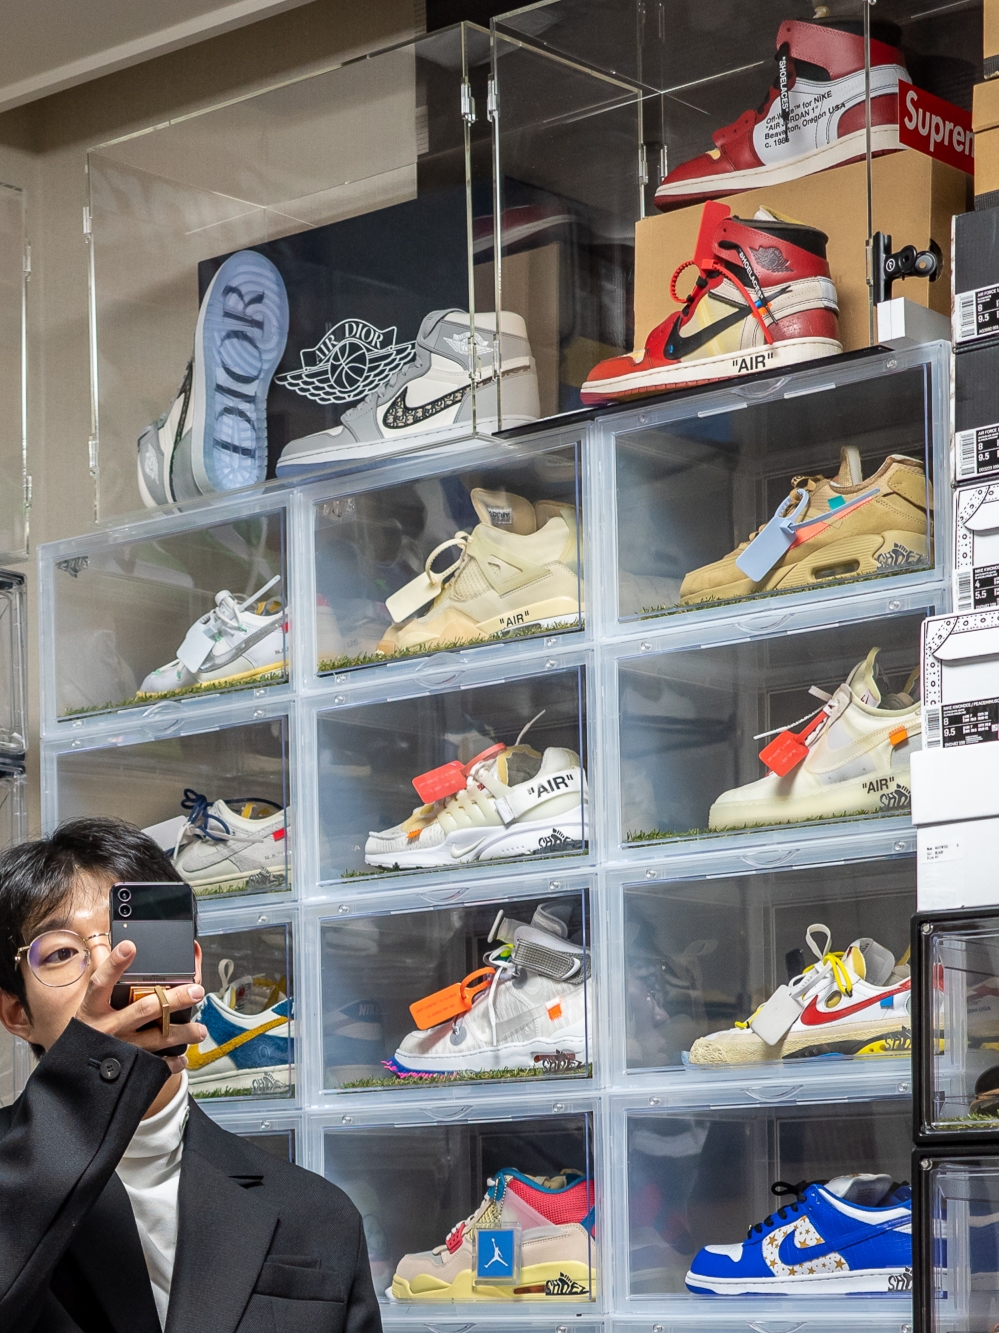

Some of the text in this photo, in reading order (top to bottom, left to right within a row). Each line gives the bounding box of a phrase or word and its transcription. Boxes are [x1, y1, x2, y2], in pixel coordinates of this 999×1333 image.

[802, 101, 812, 110] for
[813, 90, 832, 103] NIKE
[802, 111, 827, 128] Oregon
[828, 102, 846, 114] USA
[315, 321, 385, 365] AIR DIOR
[213, 284, 265, 459] DIOR
[732, 352, 774, 373] "AIR"
[500, 610, 530, 628] "AIR"
[943, 727, 956, 737] 9.5
[528, 774, 574, 799] "AIR"
[862, 776, 895, 794] "AIR"
